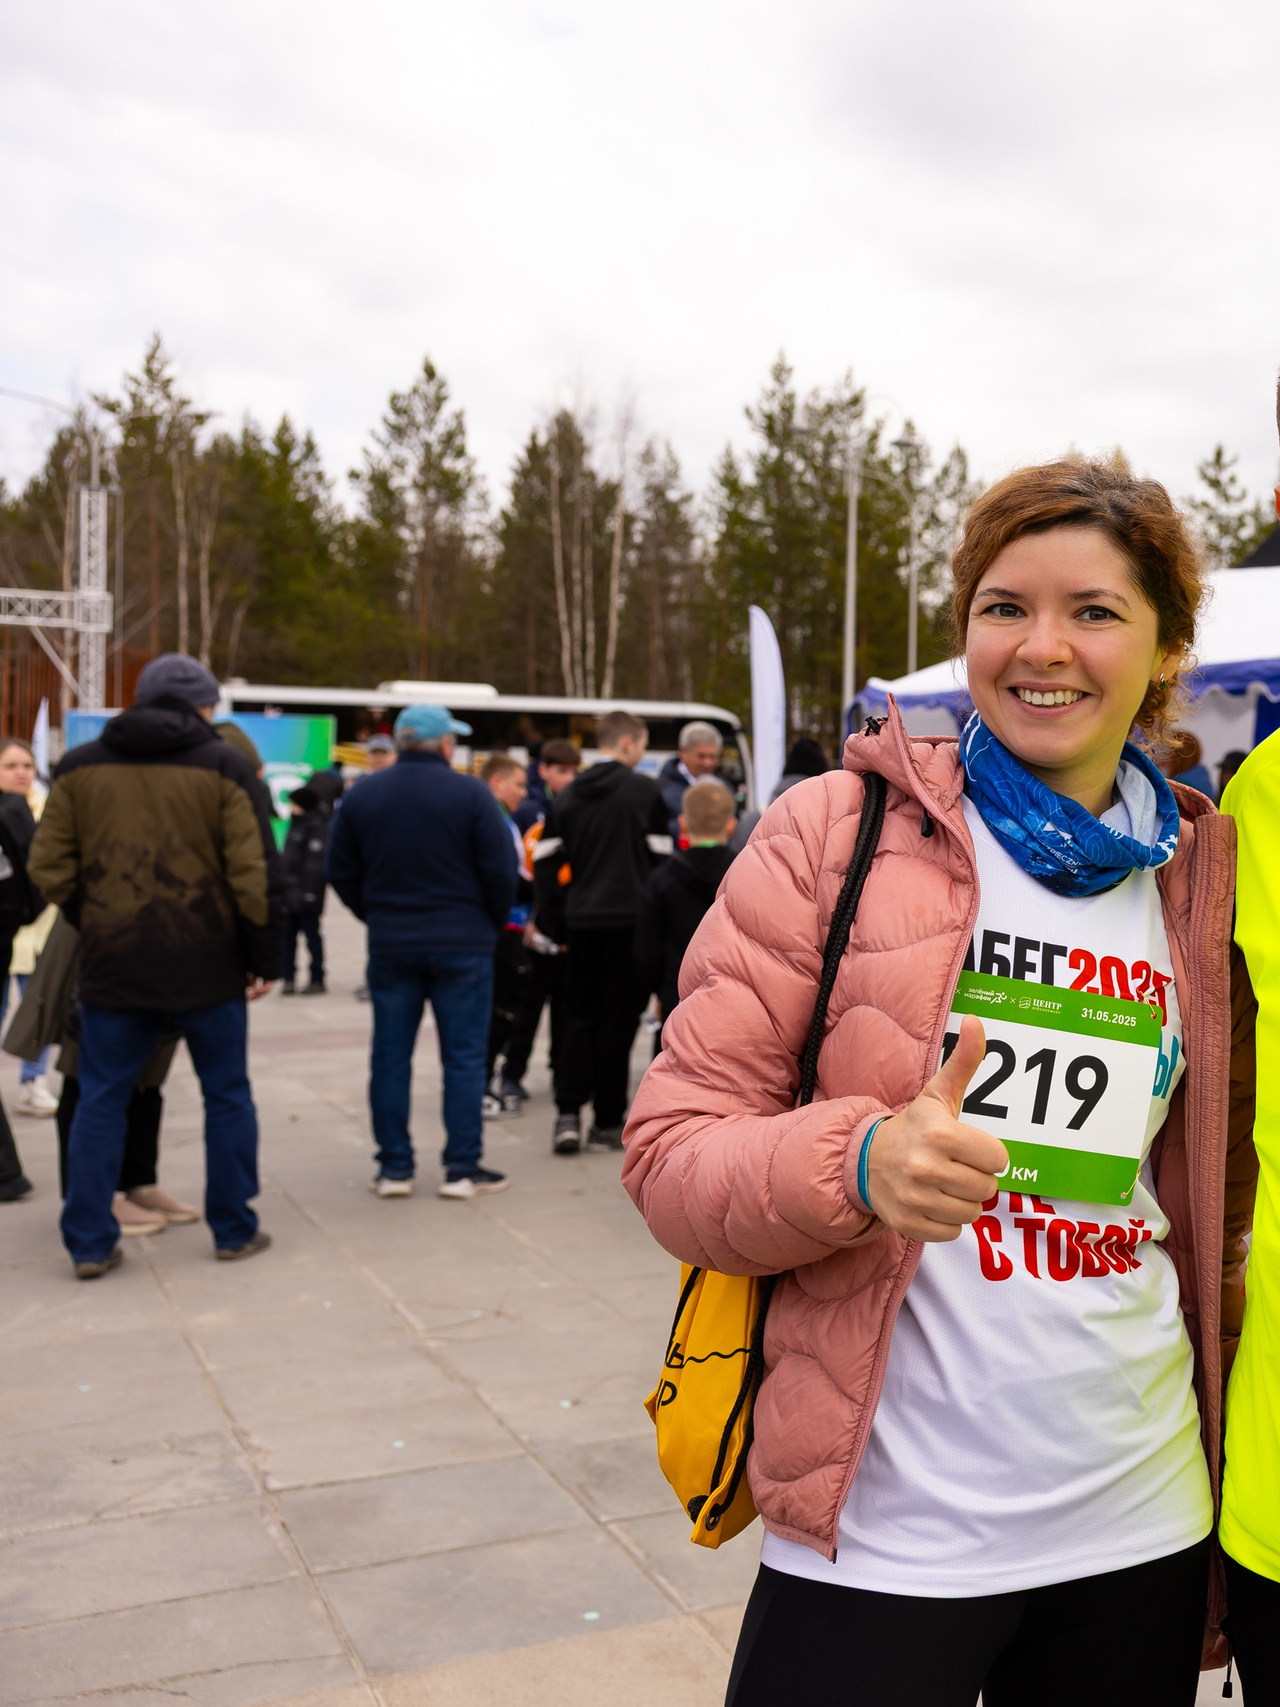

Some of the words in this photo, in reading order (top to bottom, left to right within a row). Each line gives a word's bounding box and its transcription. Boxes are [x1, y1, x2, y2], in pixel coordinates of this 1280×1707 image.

[963, 992, 992, 1002] марафон
[1032, 998, 1062, 1010] ЦЕНТР
[1080, 1007, 1137, 1027] 31.05.2025
[971, 1214, 1014, 1282] С
[1013, 1217, 1153, 1282] ТОБОЙ
